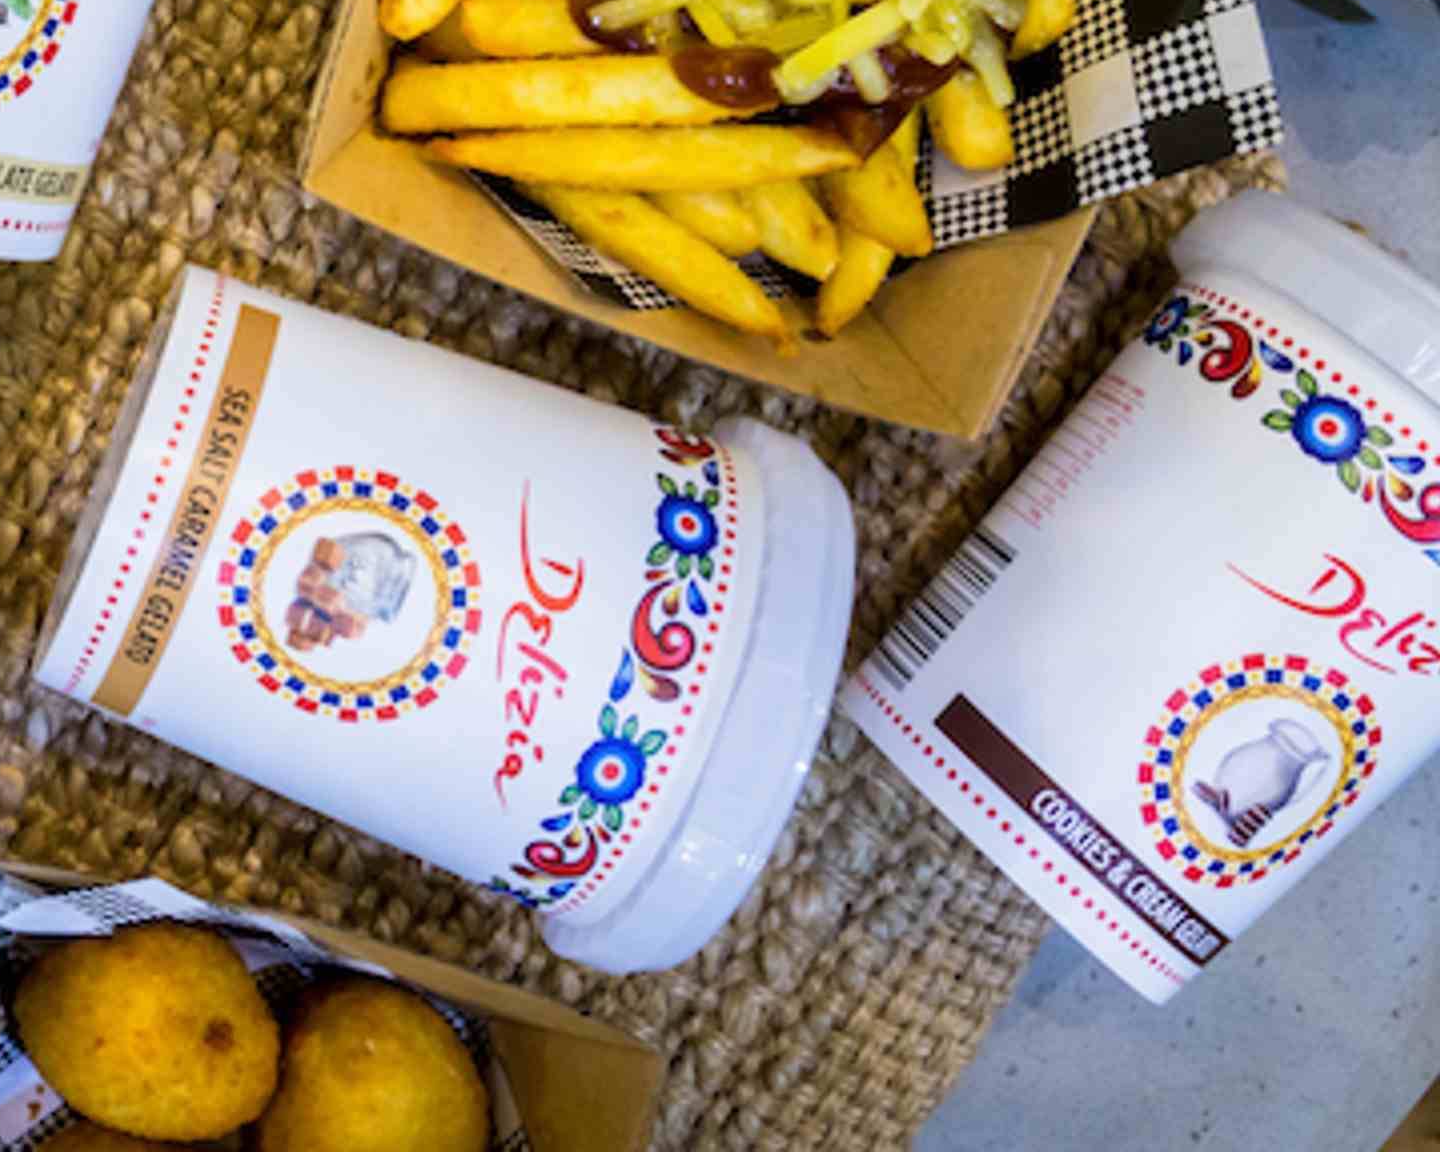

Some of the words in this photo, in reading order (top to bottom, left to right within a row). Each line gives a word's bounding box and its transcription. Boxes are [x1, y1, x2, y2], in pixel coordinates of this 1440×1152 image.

[216, 386, 251, 427] SEA
[199, 427, 238, 485] SALT
[155, 484, 219, 591] CARAMEL
[124, 593, 174, 666] GELATO
[494, 478, 585, 810] Delizia
[1031, 788, 1120, 873] COOKIES
[1105, 856, 1135, 890] &
